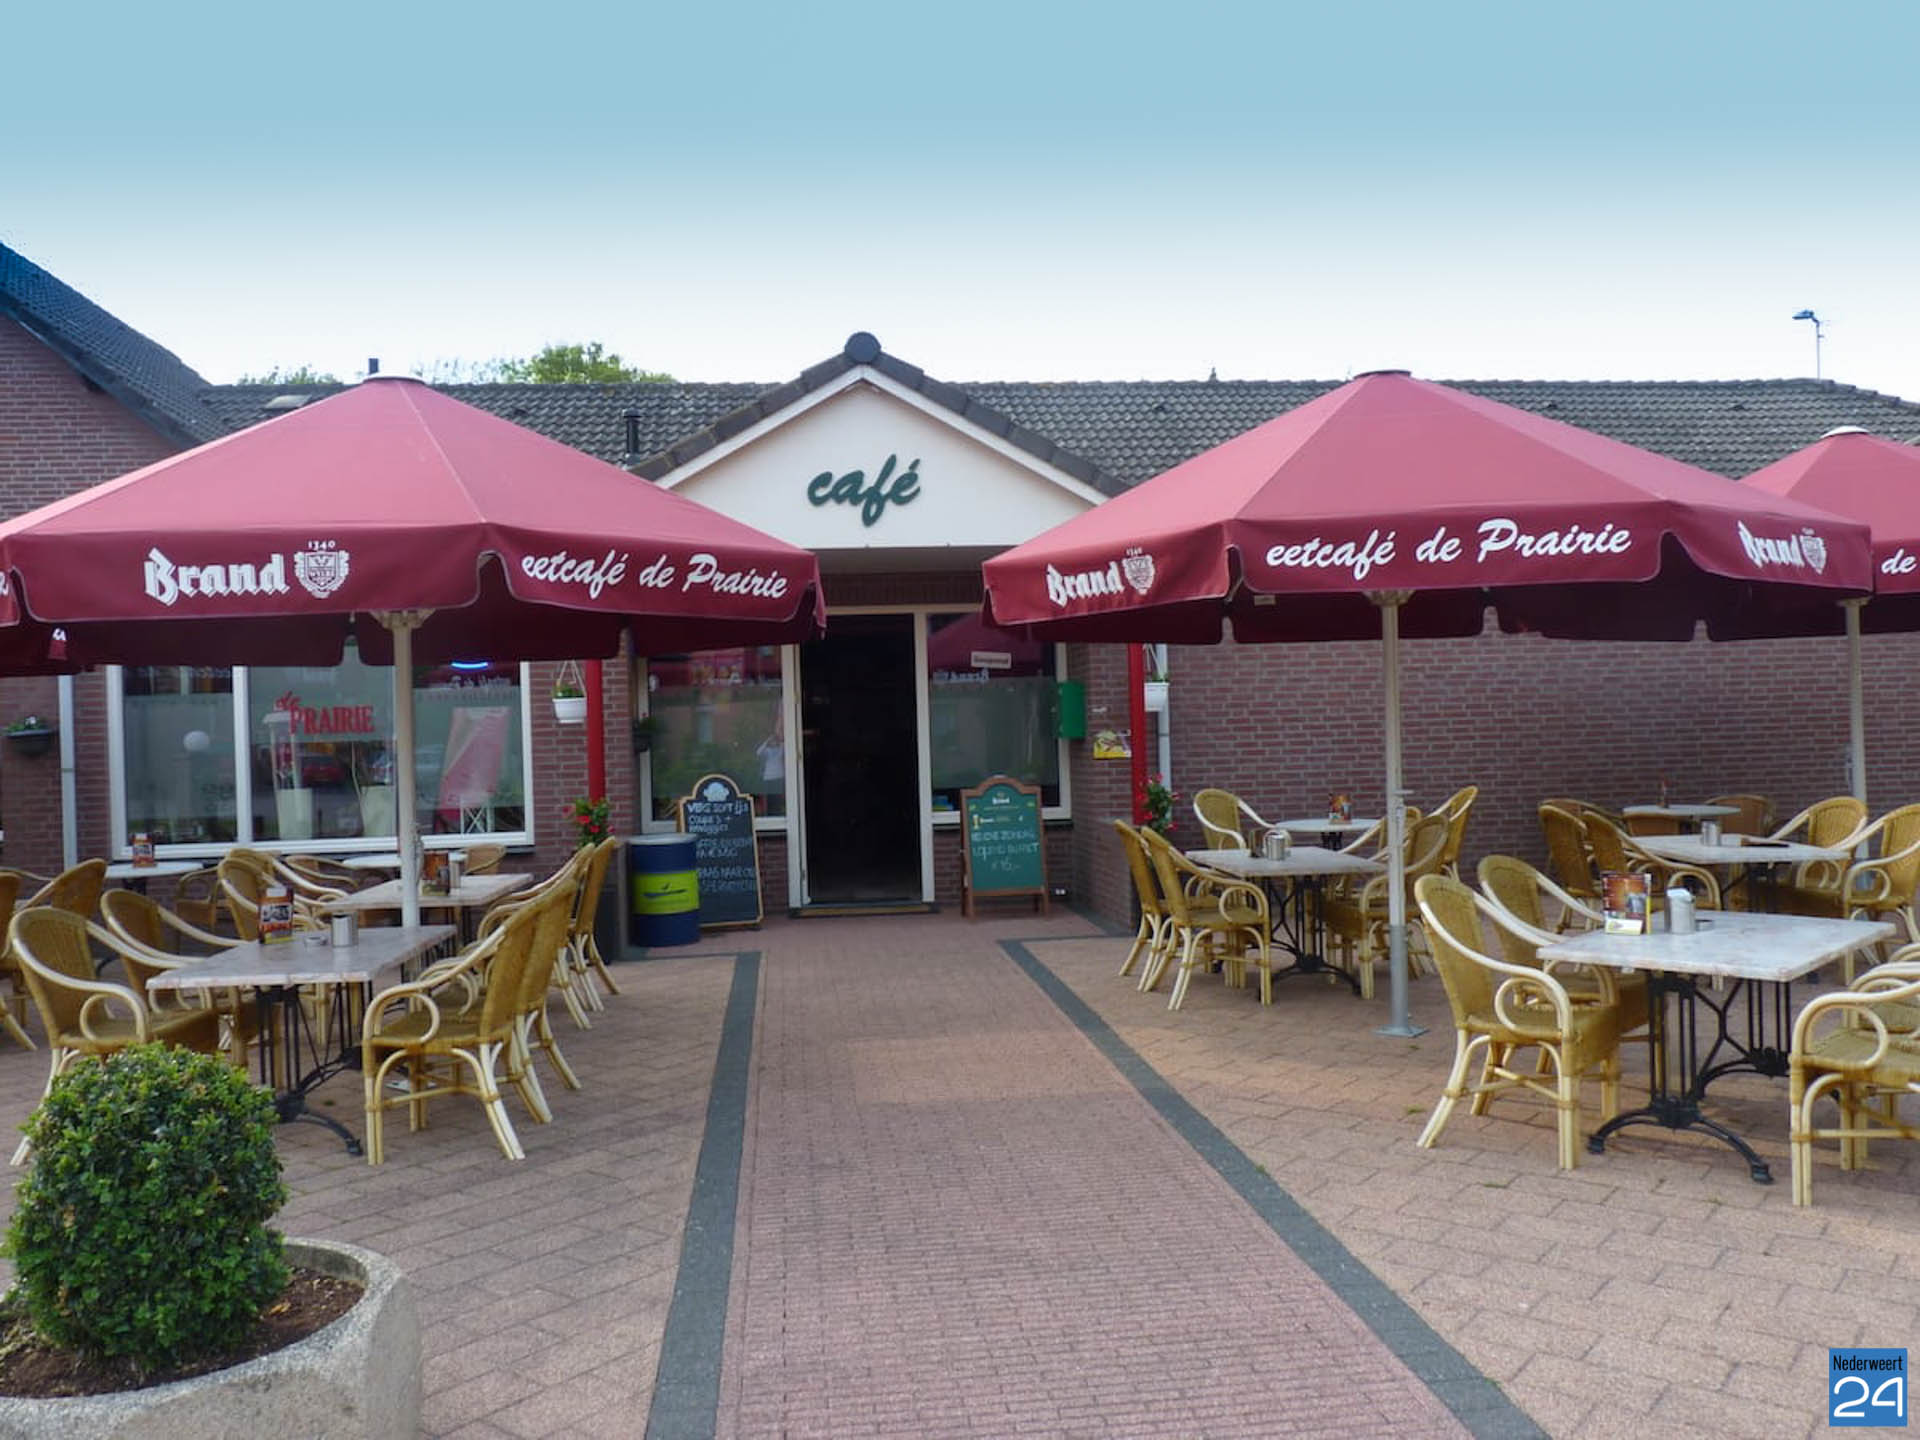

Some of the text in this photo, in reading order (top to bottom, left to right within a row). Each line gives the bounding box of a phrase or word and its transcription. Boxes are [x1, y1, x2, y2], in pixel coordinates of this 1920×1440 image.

[807, 453, 920, 528] café
[143, 547, 291, 607] Brand
[521, 549, 788, 599] eetcafé de Prairie
[1266, 518, 1632, 581] eetcafé de Prairie
[1881, 548, 1918, 575] de
[1046, 562, 1126, 609] Brand
